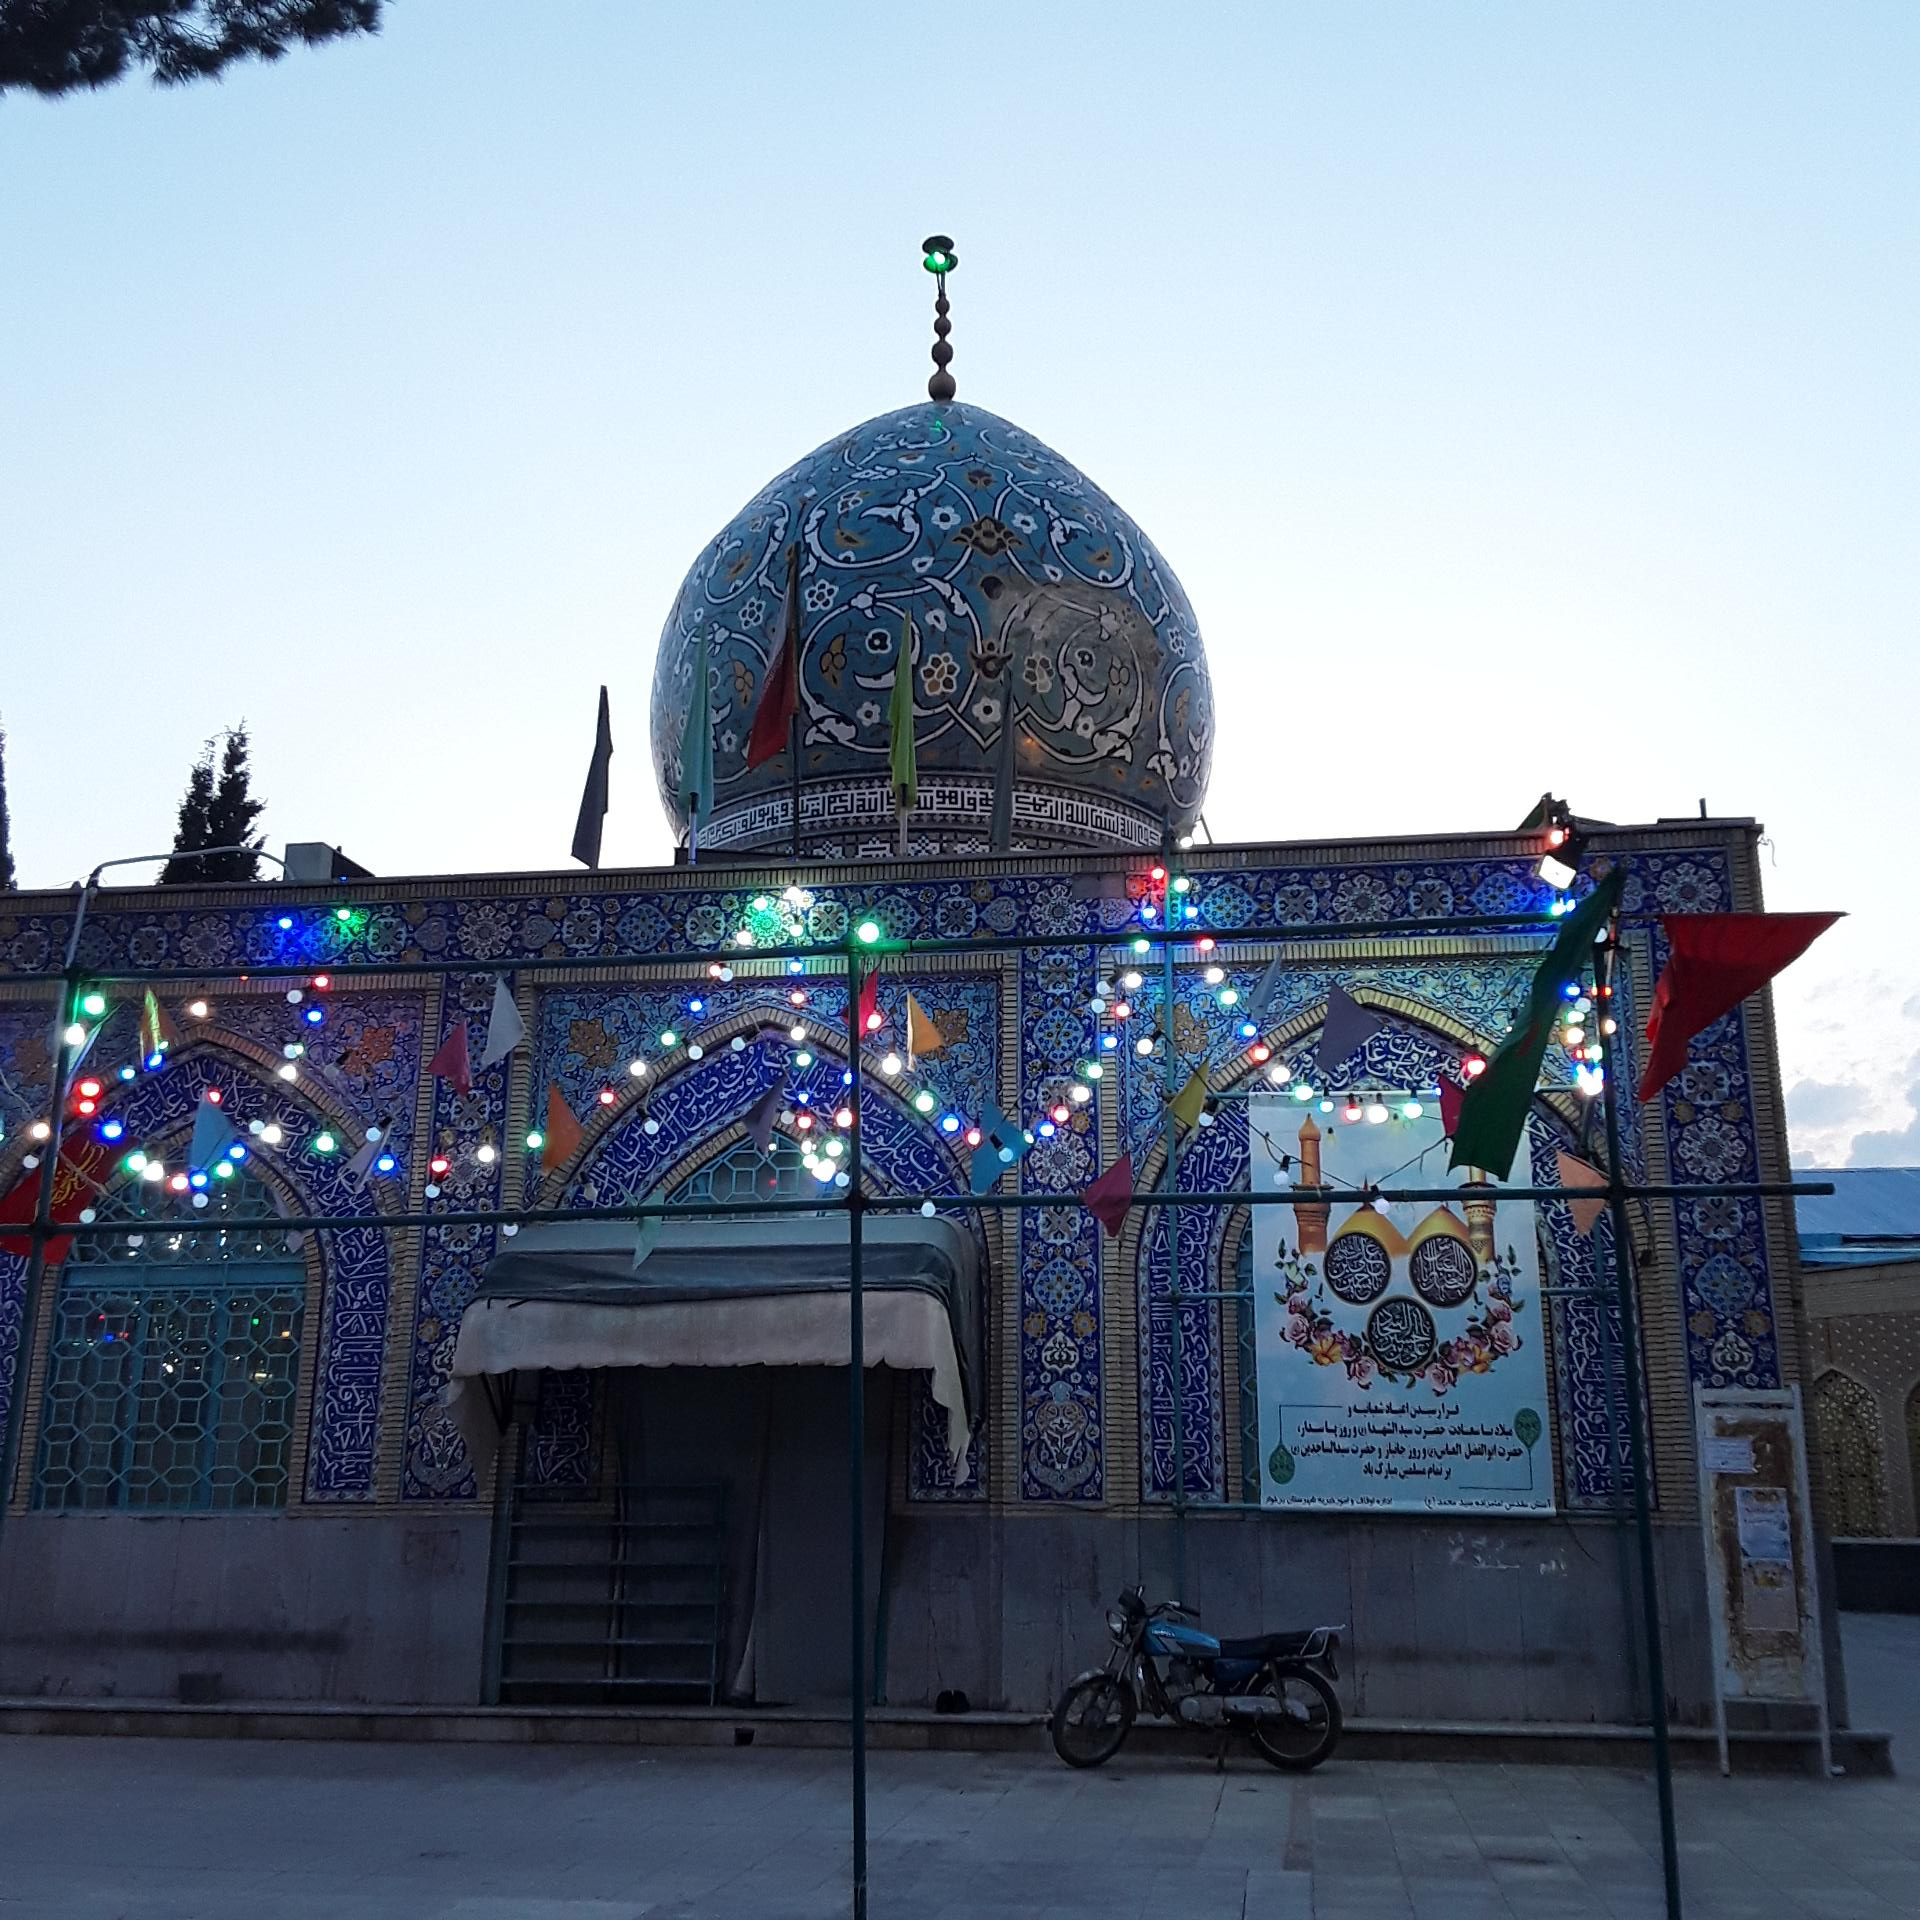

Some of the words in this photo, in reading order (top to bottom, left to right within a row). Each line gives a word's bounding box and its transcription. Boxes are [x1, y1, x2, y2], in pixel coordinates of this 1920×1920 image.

[1414, 1425, 1445, 1439] حضرت
[1351, 1443, 1376, 1459] حضرت
[1498, 1444, 1523, 1461] حضرت
